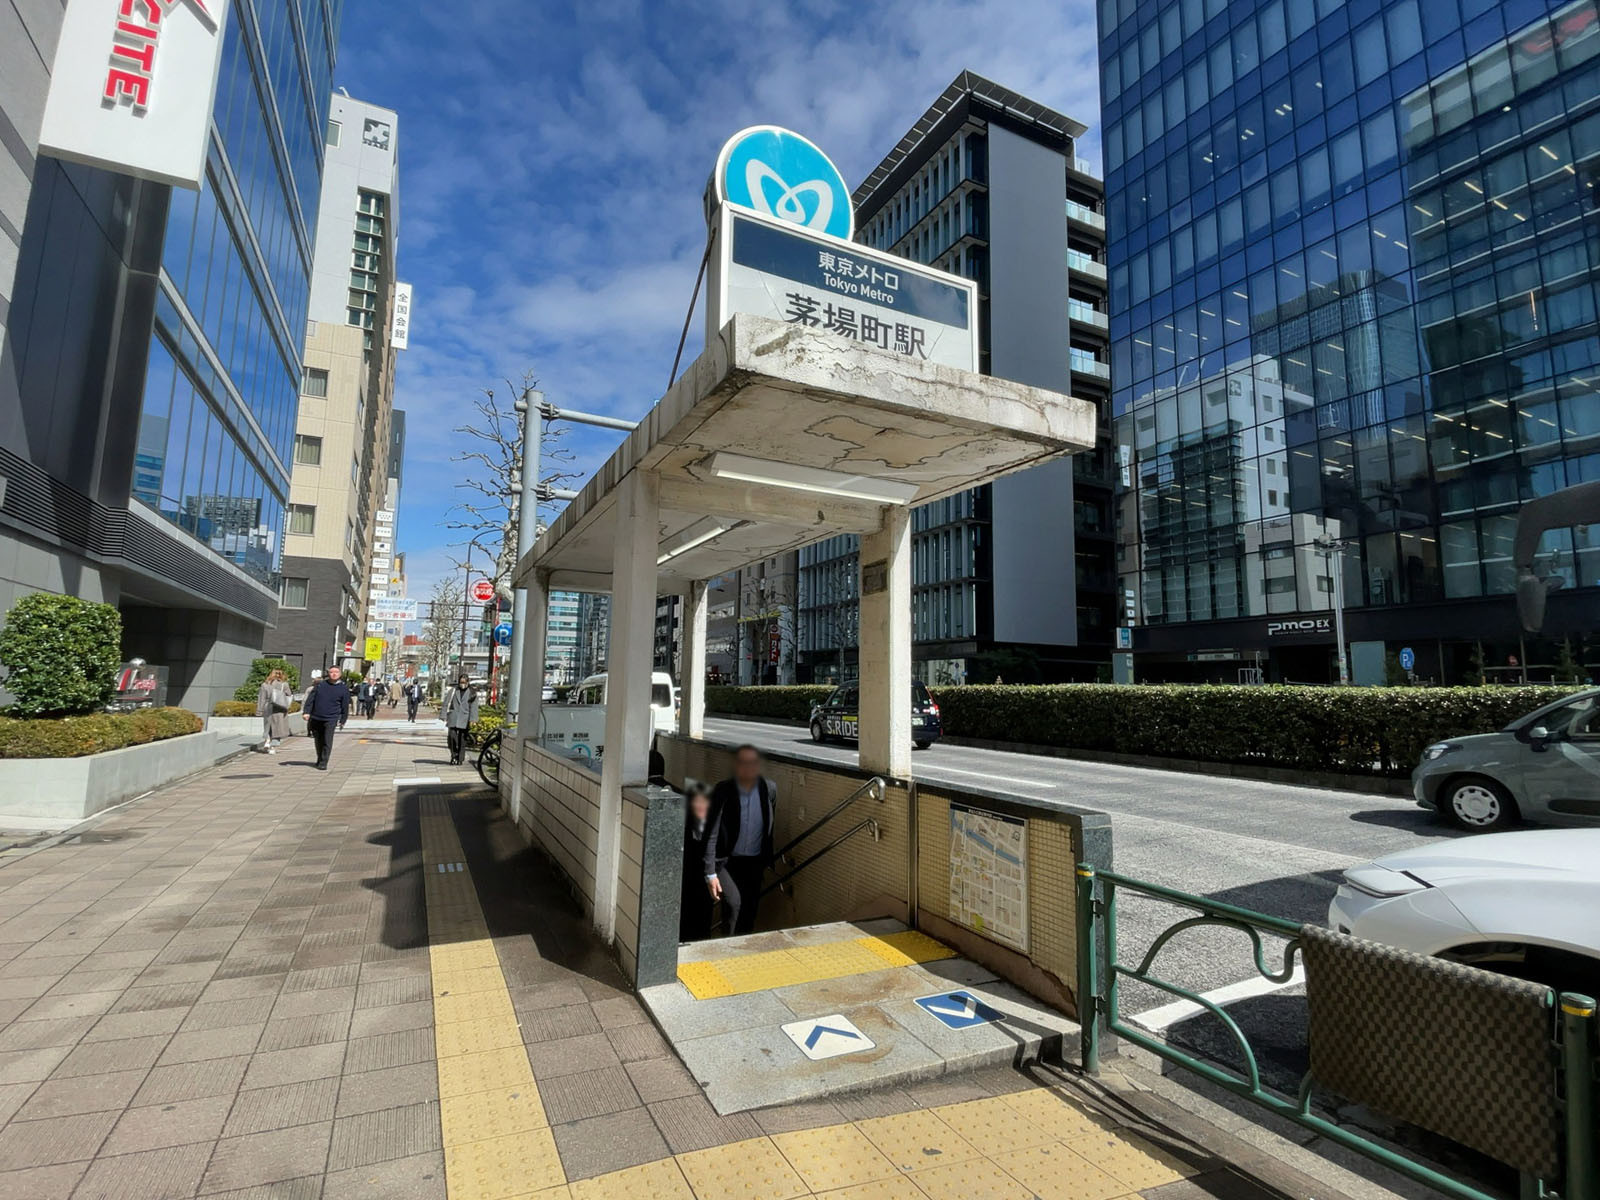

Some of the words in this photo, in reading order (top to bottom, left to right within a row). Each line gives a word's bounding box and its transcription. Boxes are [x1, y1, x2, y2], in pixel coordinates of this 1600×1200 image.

[818, 250, 900, 292] 東京メトロ
[823, 271, 858, 295] Tokyo
[860, 283, 895, 305] Metro
[394, 292, 409, 340] 全国会館
[784, 291, 928, 361] 茅場町駅
[1316, 619, 1330, 628] EX
[499, 629, 510, 645] P
[1402, 653, 1409, 668] P
[826, 719, 858, 737] S.RIDE
